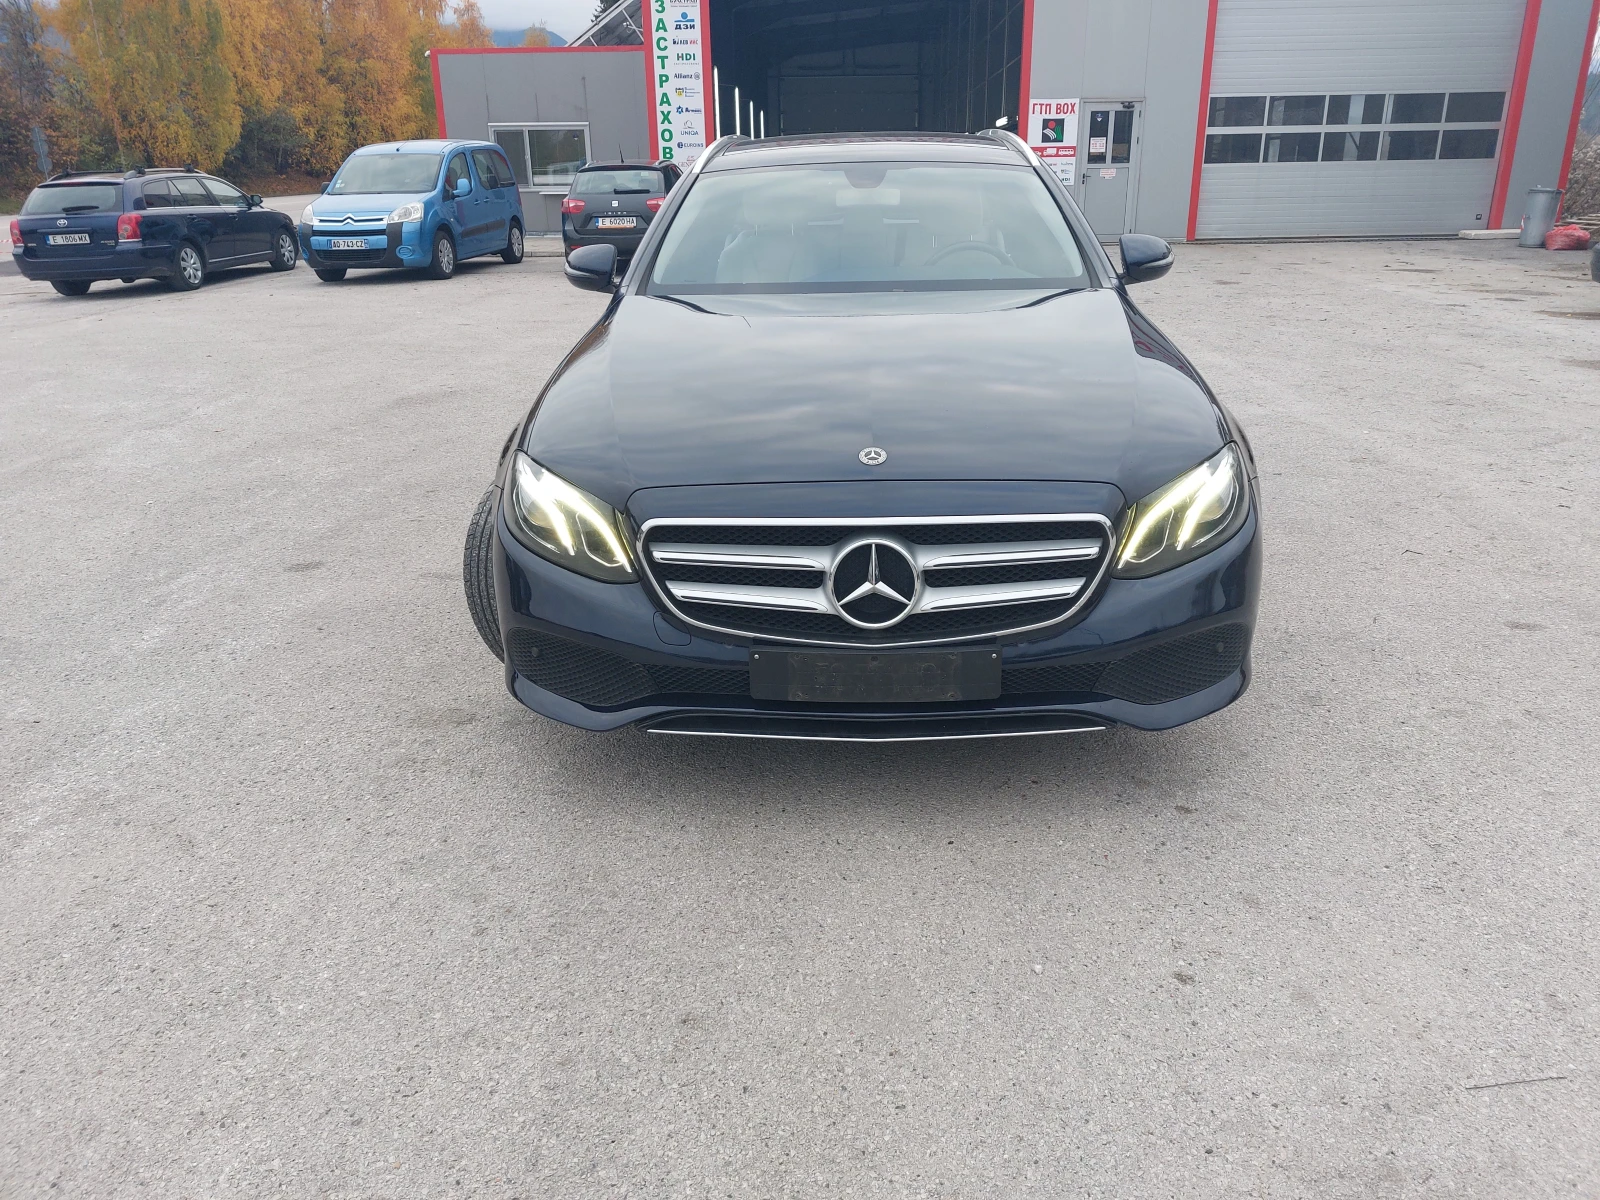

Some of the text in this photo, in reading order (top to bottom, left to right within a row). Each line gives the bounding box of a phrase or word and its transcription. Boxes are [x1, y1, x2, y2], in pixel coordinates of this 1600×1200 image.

[676, 52, 696, 61] HDI
[1032, 102, 1077, 115] ГТП BOX
